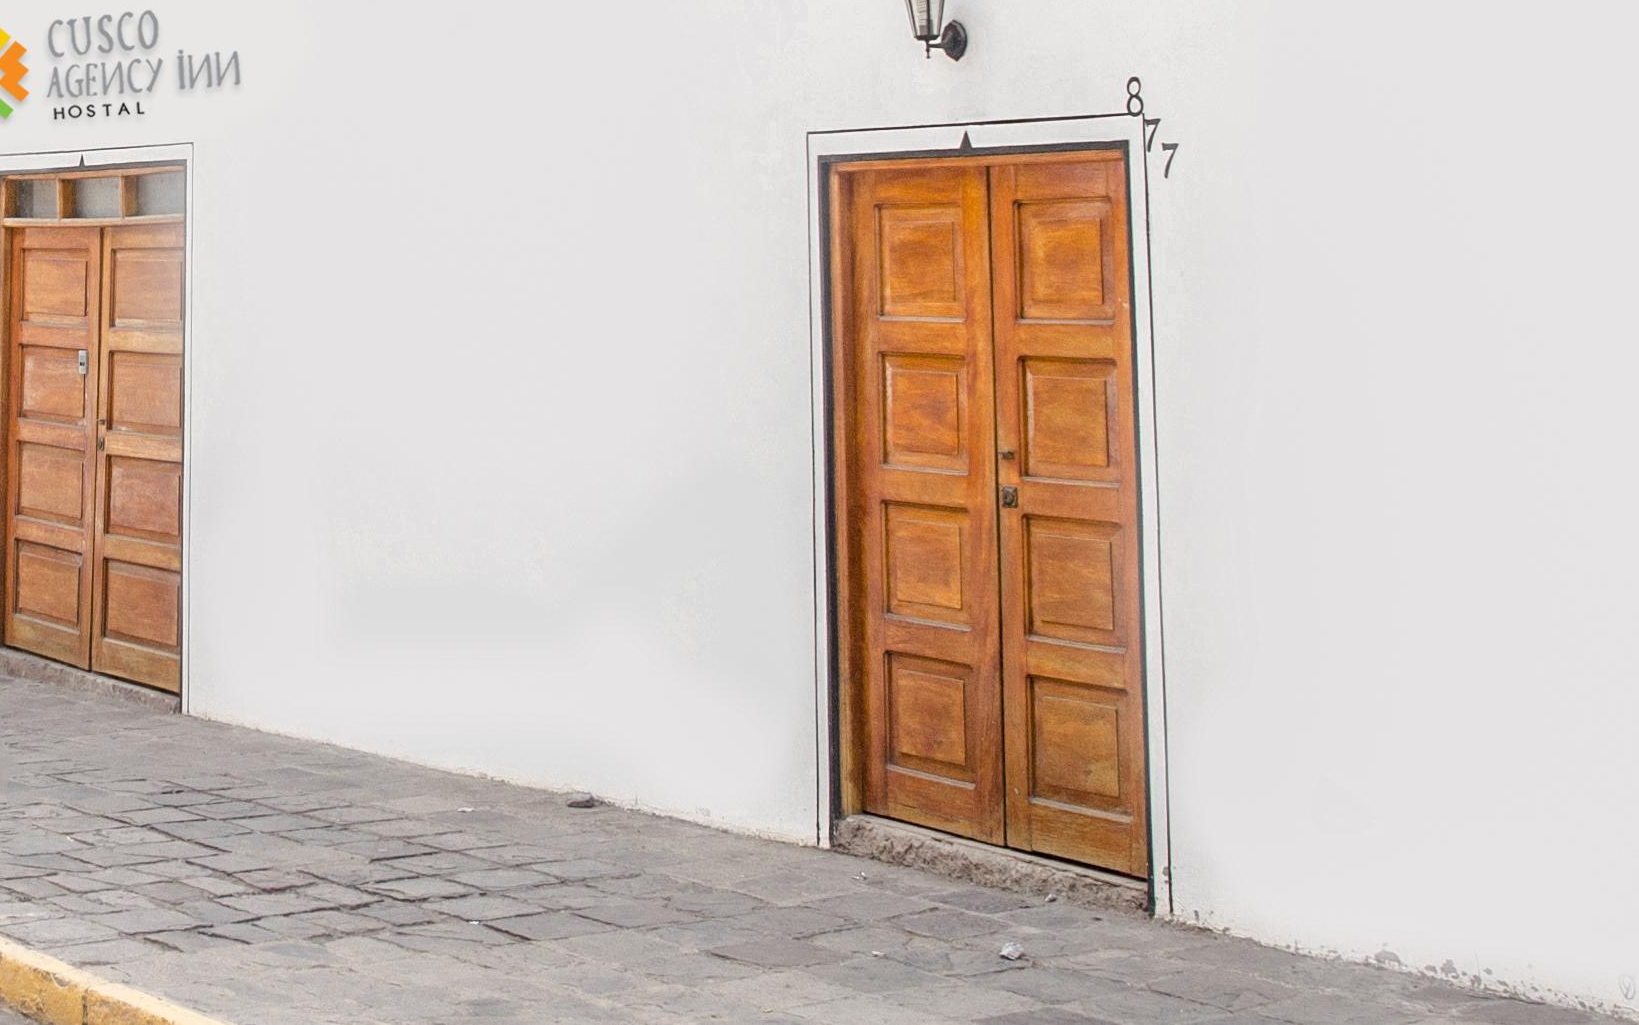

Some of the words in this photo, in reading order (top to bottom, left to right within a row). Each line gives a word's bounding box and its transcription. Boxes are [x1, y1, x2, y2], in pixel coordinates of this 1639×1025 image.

[47, 9, 159, 58] CUSCO
[46, 57, 163, 99] AGENCY
[53, 101, 145, 120] HOSTAL
